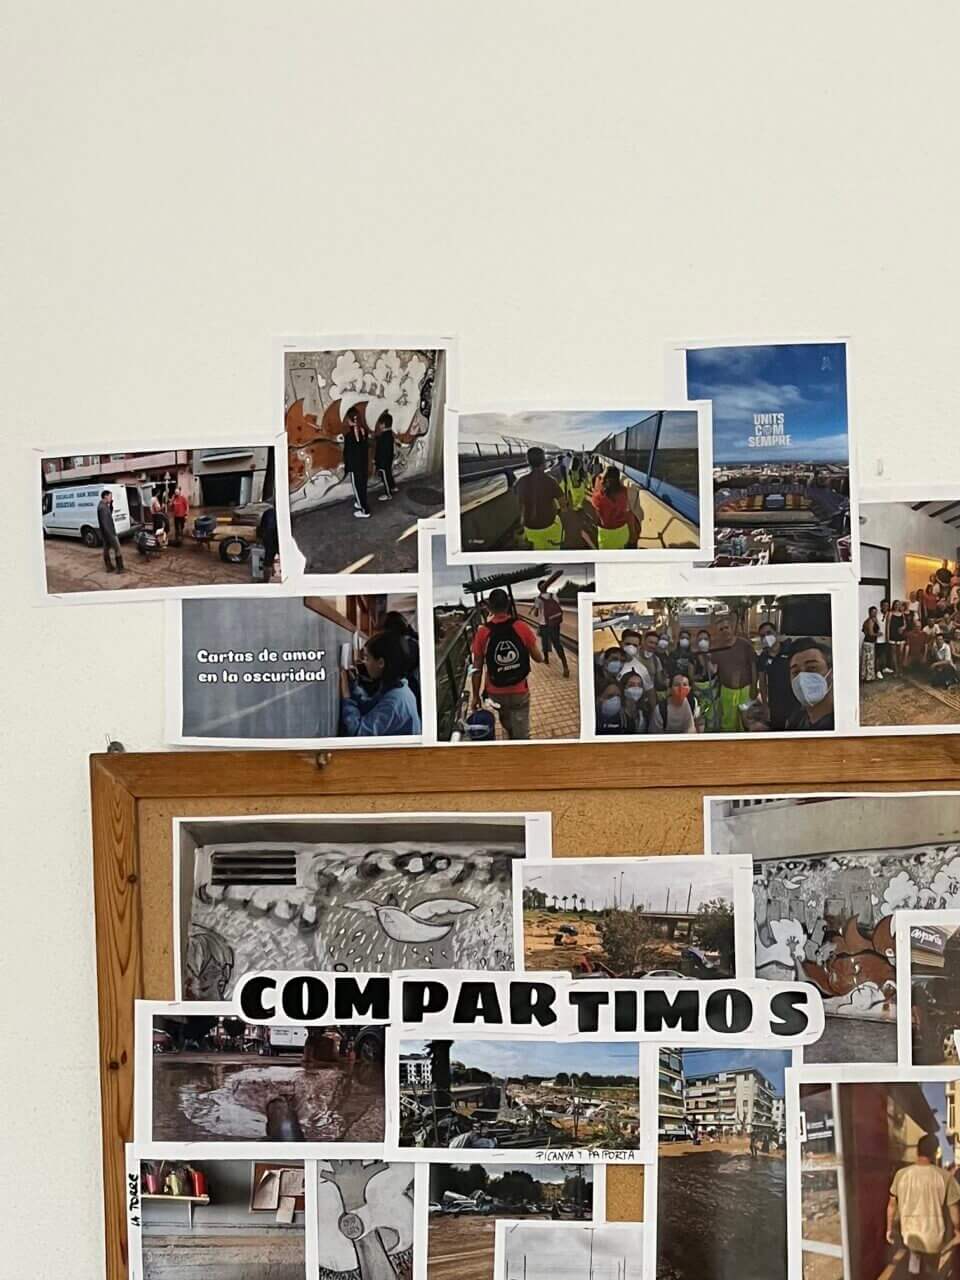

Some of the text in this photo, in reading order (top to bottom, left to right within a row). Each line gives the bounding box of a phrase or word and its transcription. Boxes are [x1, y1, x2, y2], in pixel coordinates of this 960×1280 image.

[753, 413, 785, 425] UNITS
[747, 434, 793, 448] SEMPRE
[197, 648, 325, 662] Cartas de amor
[198, 667, 326, 682] en la oscuridad
[241, 976, 809, 1036] COMPARTIMOS
